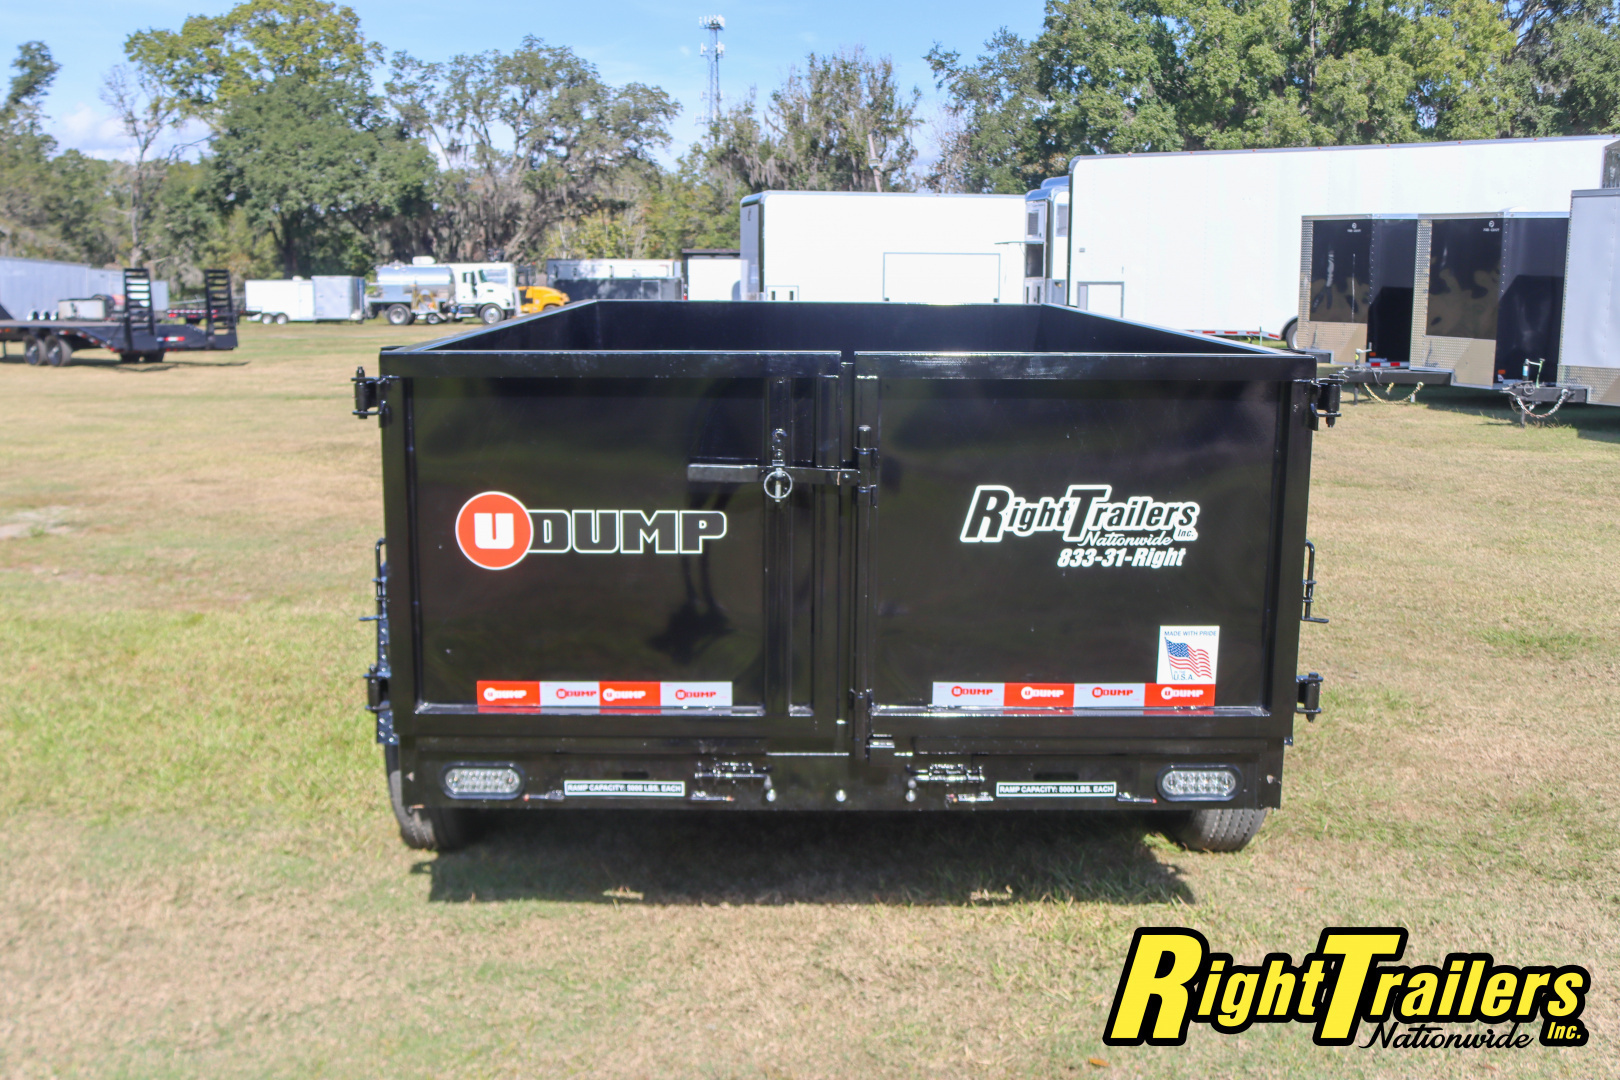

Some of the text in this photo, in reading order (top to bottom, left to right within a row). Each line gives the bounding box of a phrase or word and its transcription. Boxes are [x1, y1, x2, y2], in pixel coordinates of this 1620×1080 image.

[1077, 528, 1196, 547] Nationwide Inc.
[1057, 547, 1187, 569] 833-31-Right
[1173, 673, 1195, 681] U.S.A.
[568, 784, 588, 792] RAMP
[589, 784, 626, 792] CAPACITY:
[661, 785, 681, 793] EACH
[1093, 785, 1113, 793] EACH
